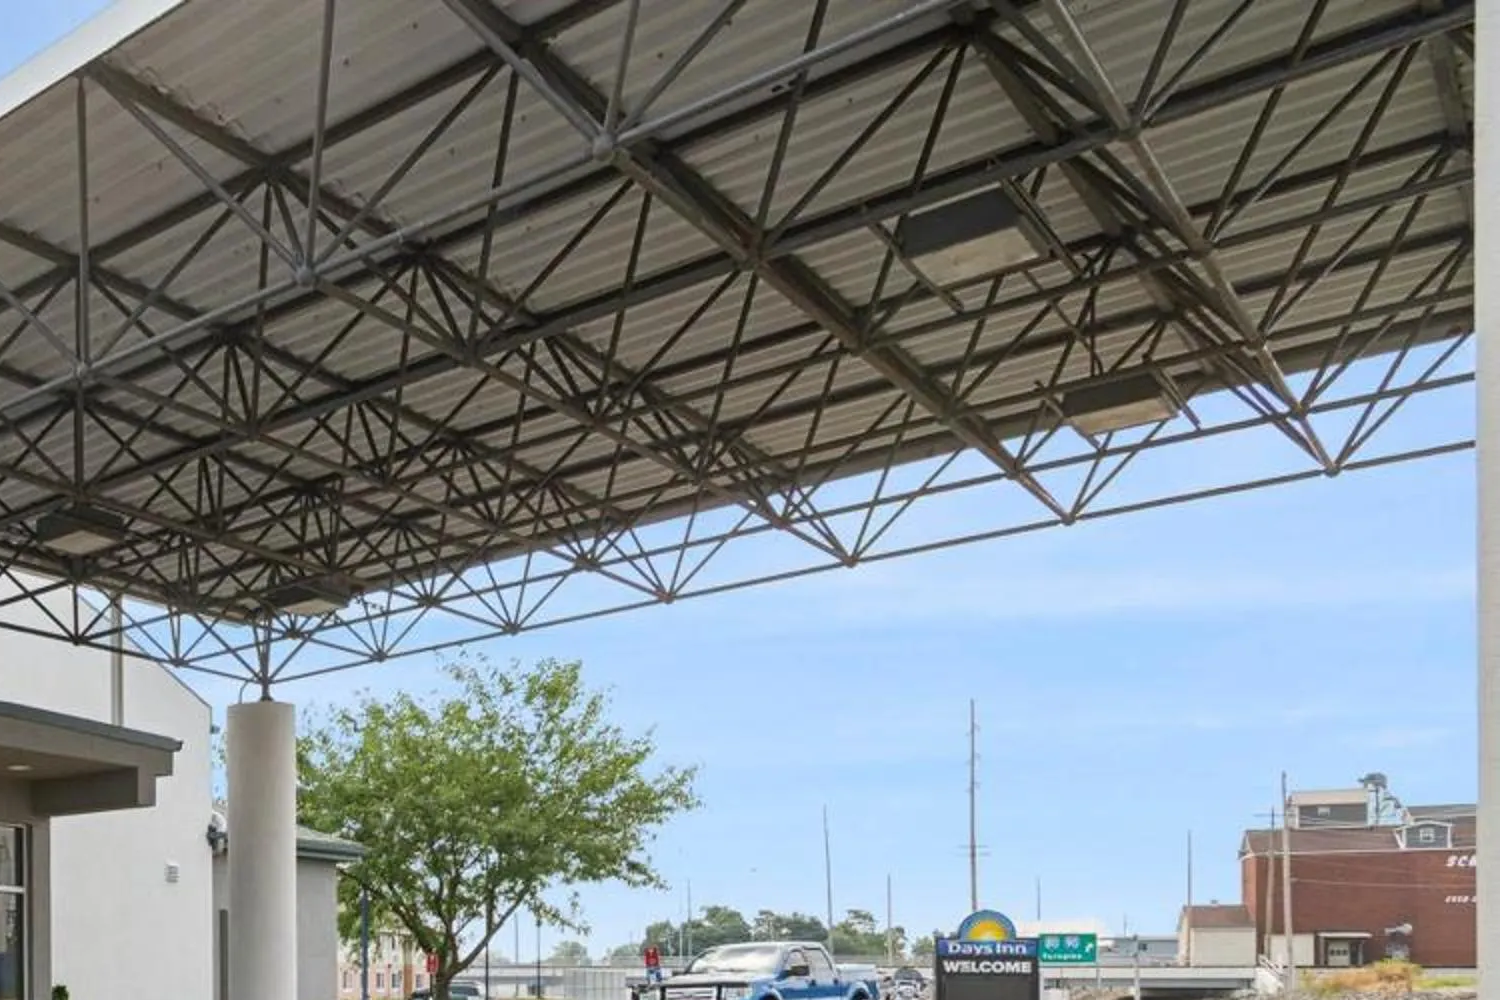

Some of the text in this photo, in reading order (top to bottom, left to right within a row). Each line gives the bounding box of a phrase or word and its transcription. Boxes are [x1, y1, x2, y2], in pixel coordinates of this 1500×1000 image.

[947, 942, 1027, 956] Days Inn
[942, 960, 1033, 973] WELCOME
